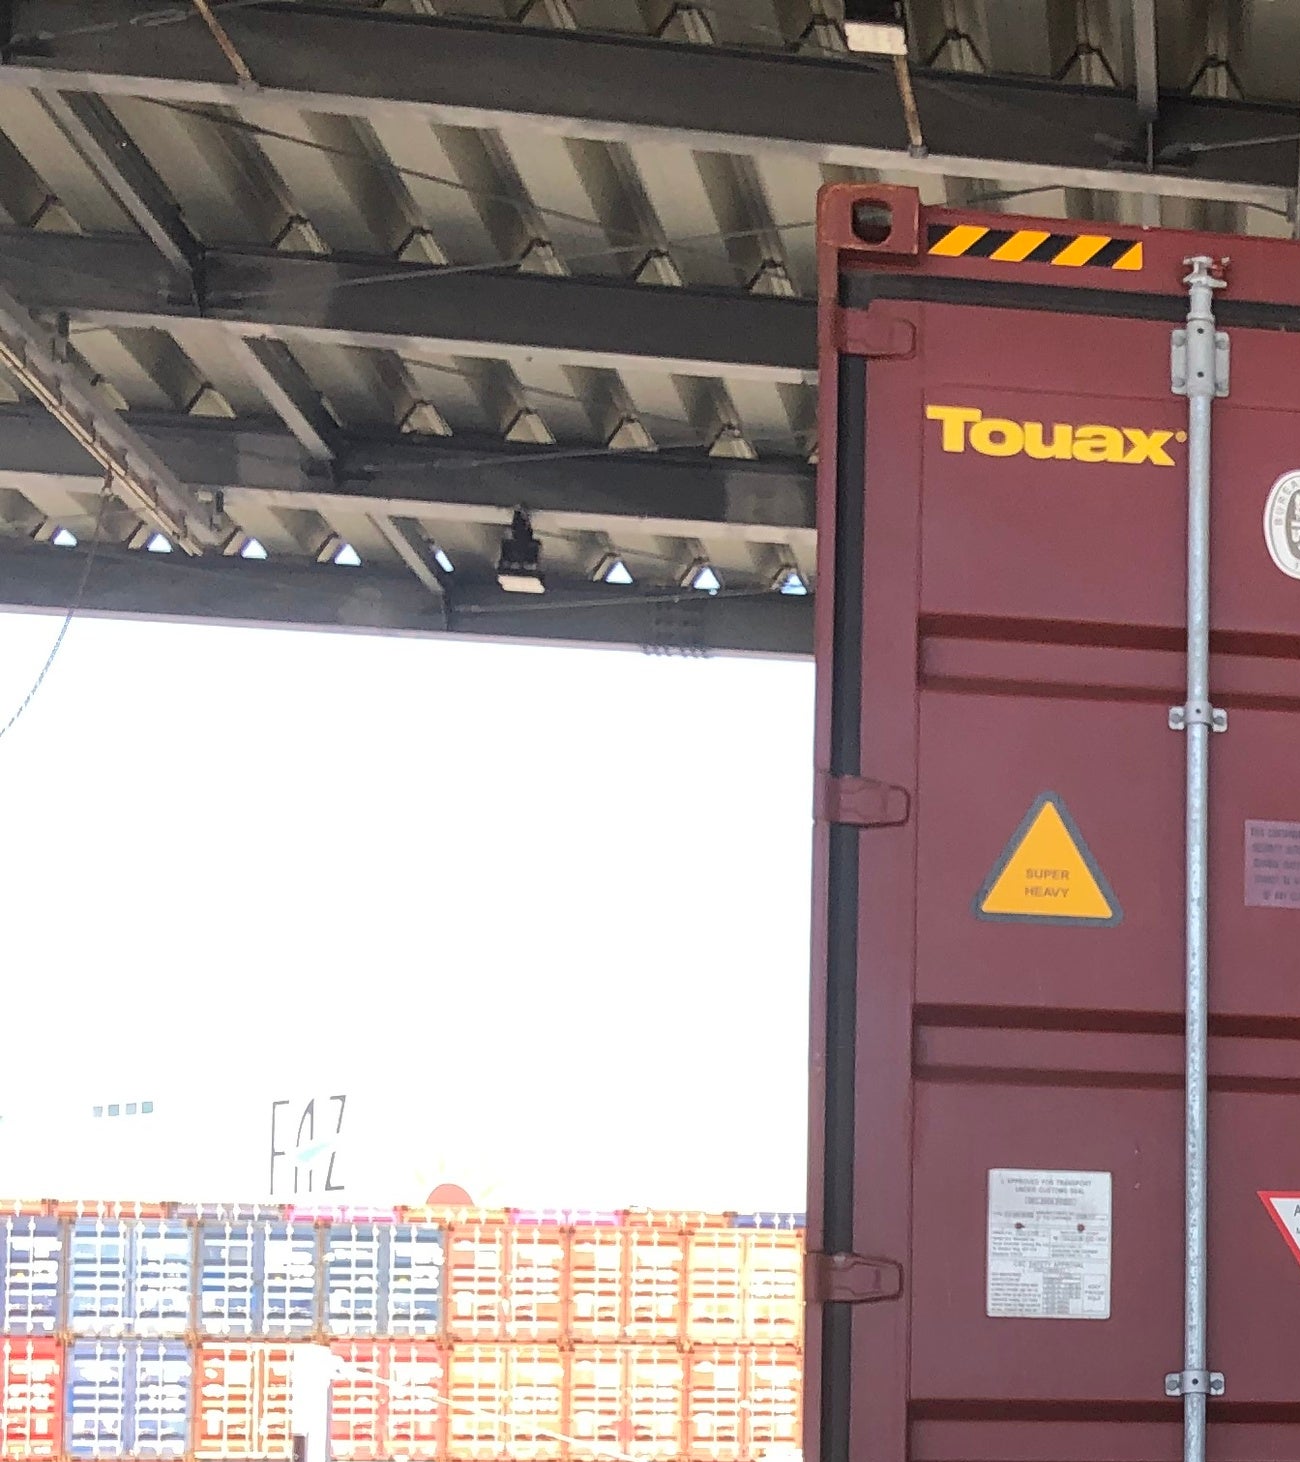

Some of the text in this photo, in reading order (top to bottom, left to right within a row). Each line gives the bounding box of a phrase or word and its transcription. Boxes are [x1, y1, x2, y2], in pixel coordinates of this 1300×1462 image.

[926, 404, 1175, 466] Touax
[1026, 868, 1070, 880] SUPER
[1025, 887, 1070, 898] HEAVY
